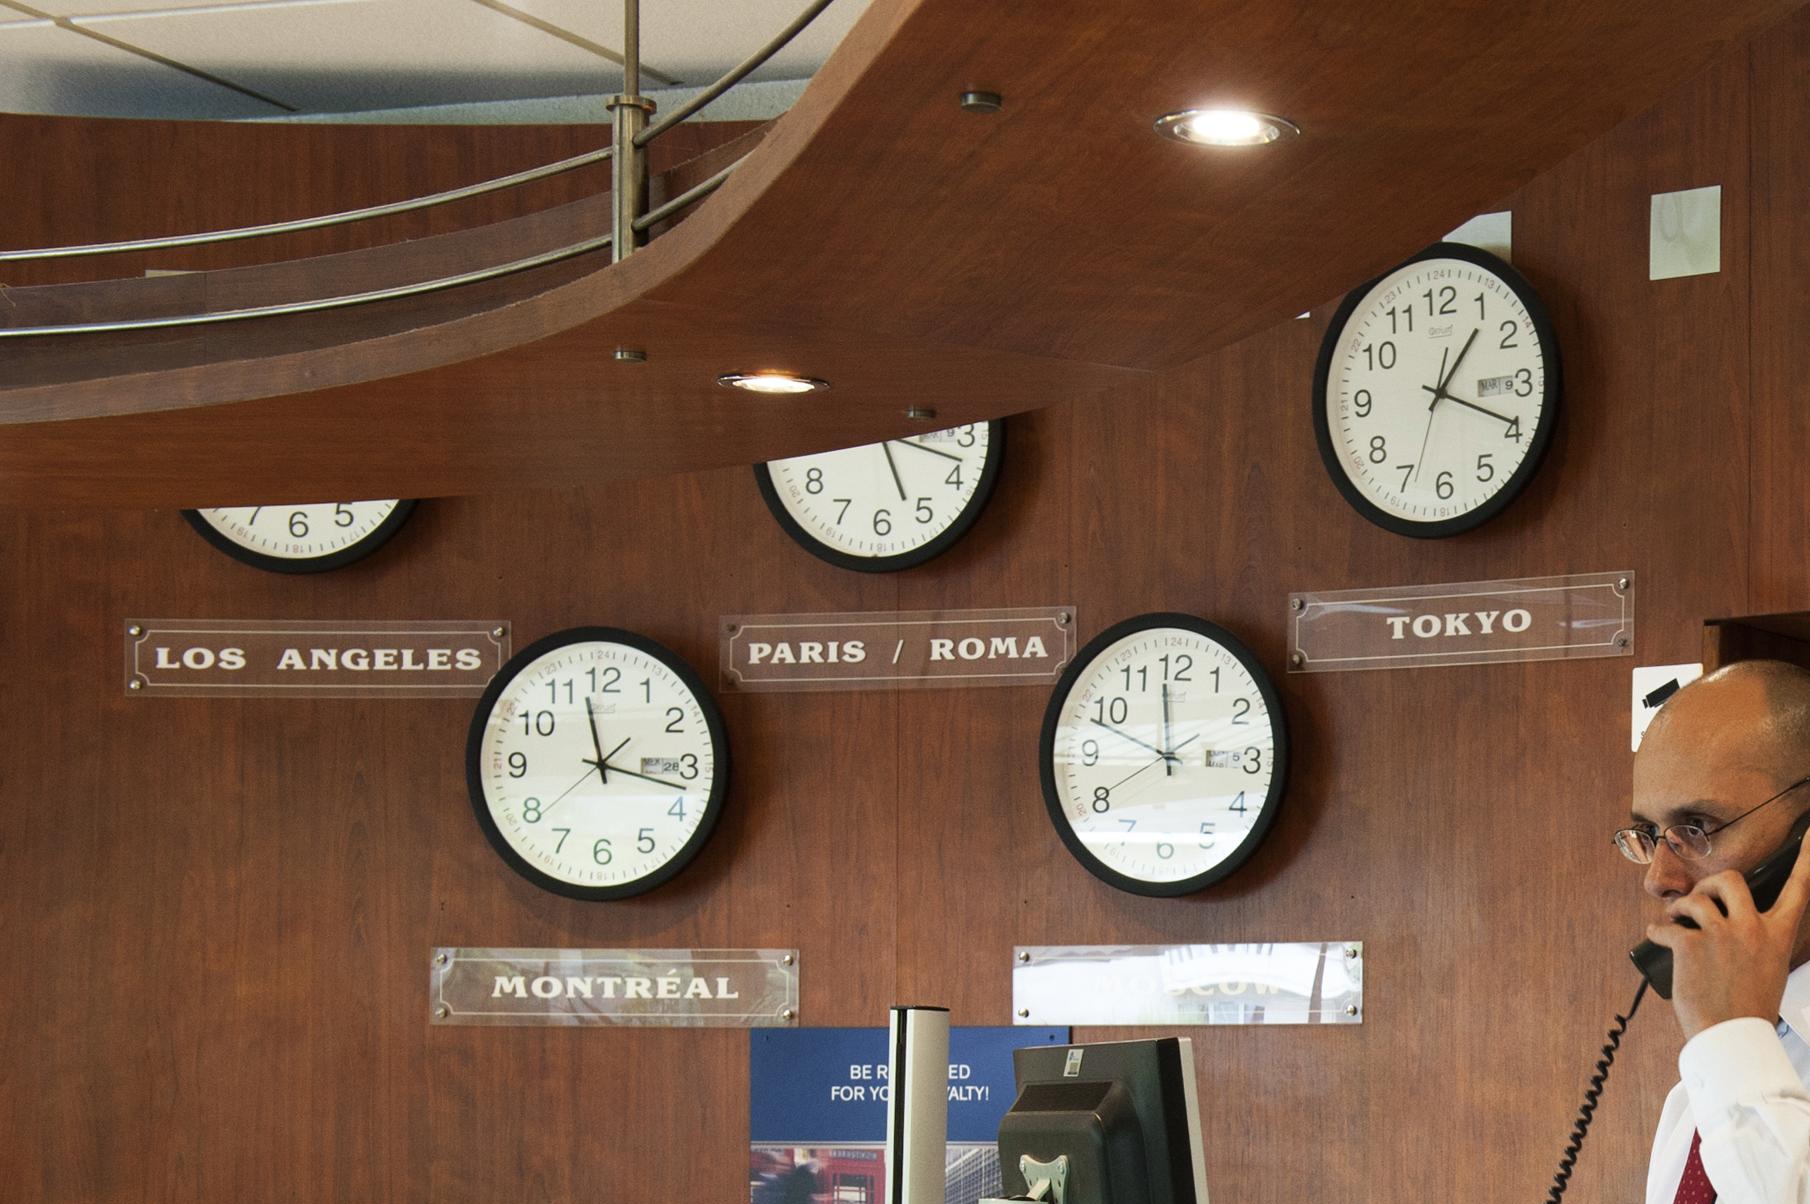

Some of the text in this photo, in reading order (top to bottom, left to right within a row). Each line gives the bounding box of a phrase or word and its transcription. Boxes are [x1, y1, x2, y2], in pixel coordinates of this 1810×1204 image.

[1423, 286, 1457, 317] 12
[1474, 292, 1485, 321] 1
[1386, 304, 1413, 335] 11
[1499, 320, 1518, 350] 2
[1362, 341, 1396, 371] 10
[1514, 368, 1533, 397] 3
[1354, 389, 1372, 418] 9
[957, 424, 976, 448] 3
[1504, 416, 1523, 444] 4
[1369, 435, 1387, 464] 8
[806, 468, 824, 494] 8
[945, 464, 964, 490] 4
[1396, 464, 1414, 493] 7
[1476, 454, 1494, 482] 5
[1436, 471, 1454, 500] 6
[334, 502, 354, 527] 5
[833, 499, 852, 525] 7
[873, 509, 891, 535] 6
[915, 497, 933, 523] 5
[289, 512, 309, 537] 6
[1387, 608, 1532, 640] TOKYO
[155, 647, 482, 672] LOS ANGELES
[748, 640, 866, 665] PARIS
[929, 635, 1048, 662] ROMA
[585, 667, 621, 693] 12
[1121, 665, 1147, 692] 11
[1159, 653, 1192, 681] 12
[1210, 666, 1220, 694] 1
[545, 678, 574, 705] 11
[640, 678, 651, 704] 1
[518, 710, 555, 737] 10
[665, 707, 685, 733] 2
[1094, 696, 1127, 724] 10
[1231, 698, 1250, 725] 2
[508, 752, 527, 778] 9
[679, 753, 698, 779] 3
[1082, 739, 1099, 766] 9
[1243, 747, 1261, 774] 3
[663, 762, 680, 772] 28
[522, 797, 541, 823] 8
[667, 796, 686, 822] 4
[1092, 787, 1110, 813] 8
[1229, 791, 1247, 818] 4
[551, 828, 571, 854] 7
[593, 838, 612, 865] 6
[636, 828, 655, 854] 5
[490, 968, 739, 1001] MONTRÉAL
[850, 1064, 872, 1080] BE
[831, 1086, 865, 1101] FOR
